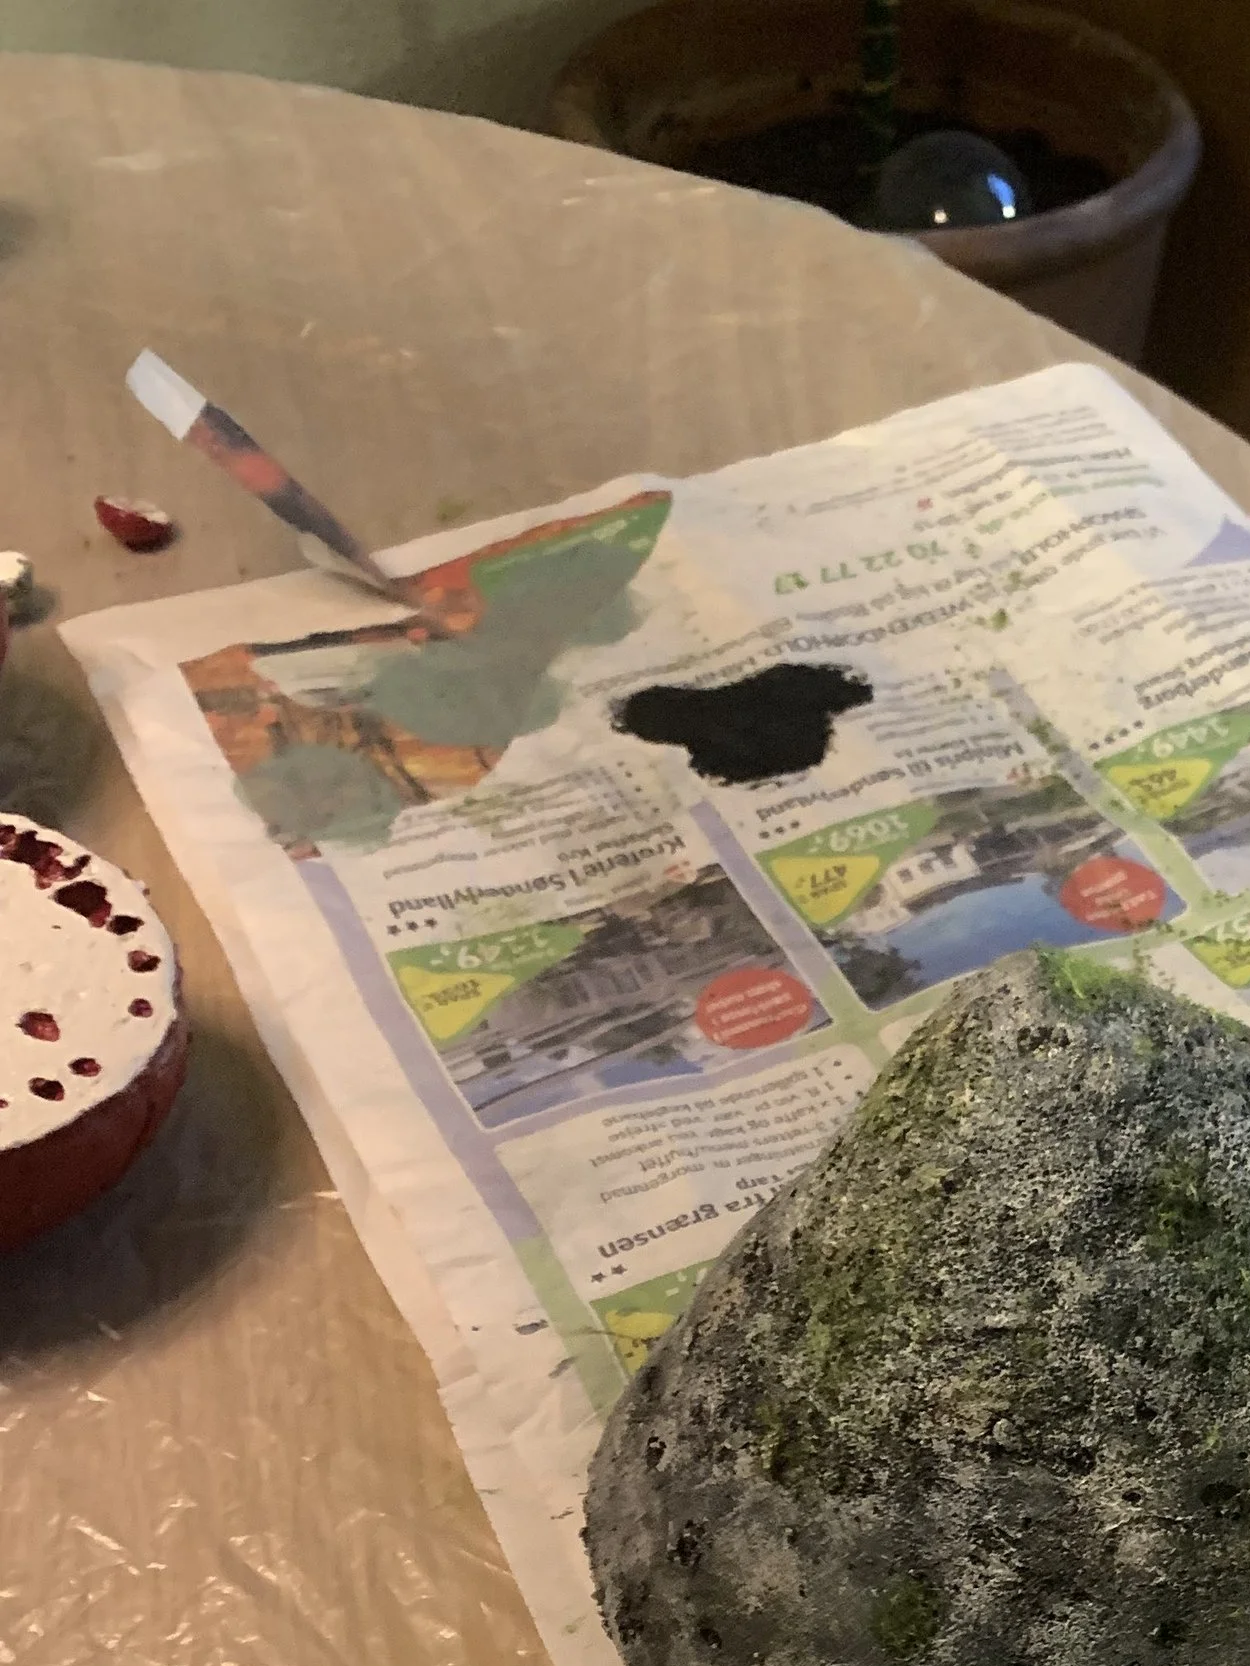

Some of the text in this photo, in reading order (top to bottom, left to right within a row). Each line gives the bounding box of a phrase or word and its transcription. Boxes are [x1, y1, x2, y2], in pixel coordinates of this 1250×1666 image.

[599, 1162, 705, 1203] morgenmad
[725, 1190, 768, 1214] fra
[596, 1200, 718, 1262] grænsen
